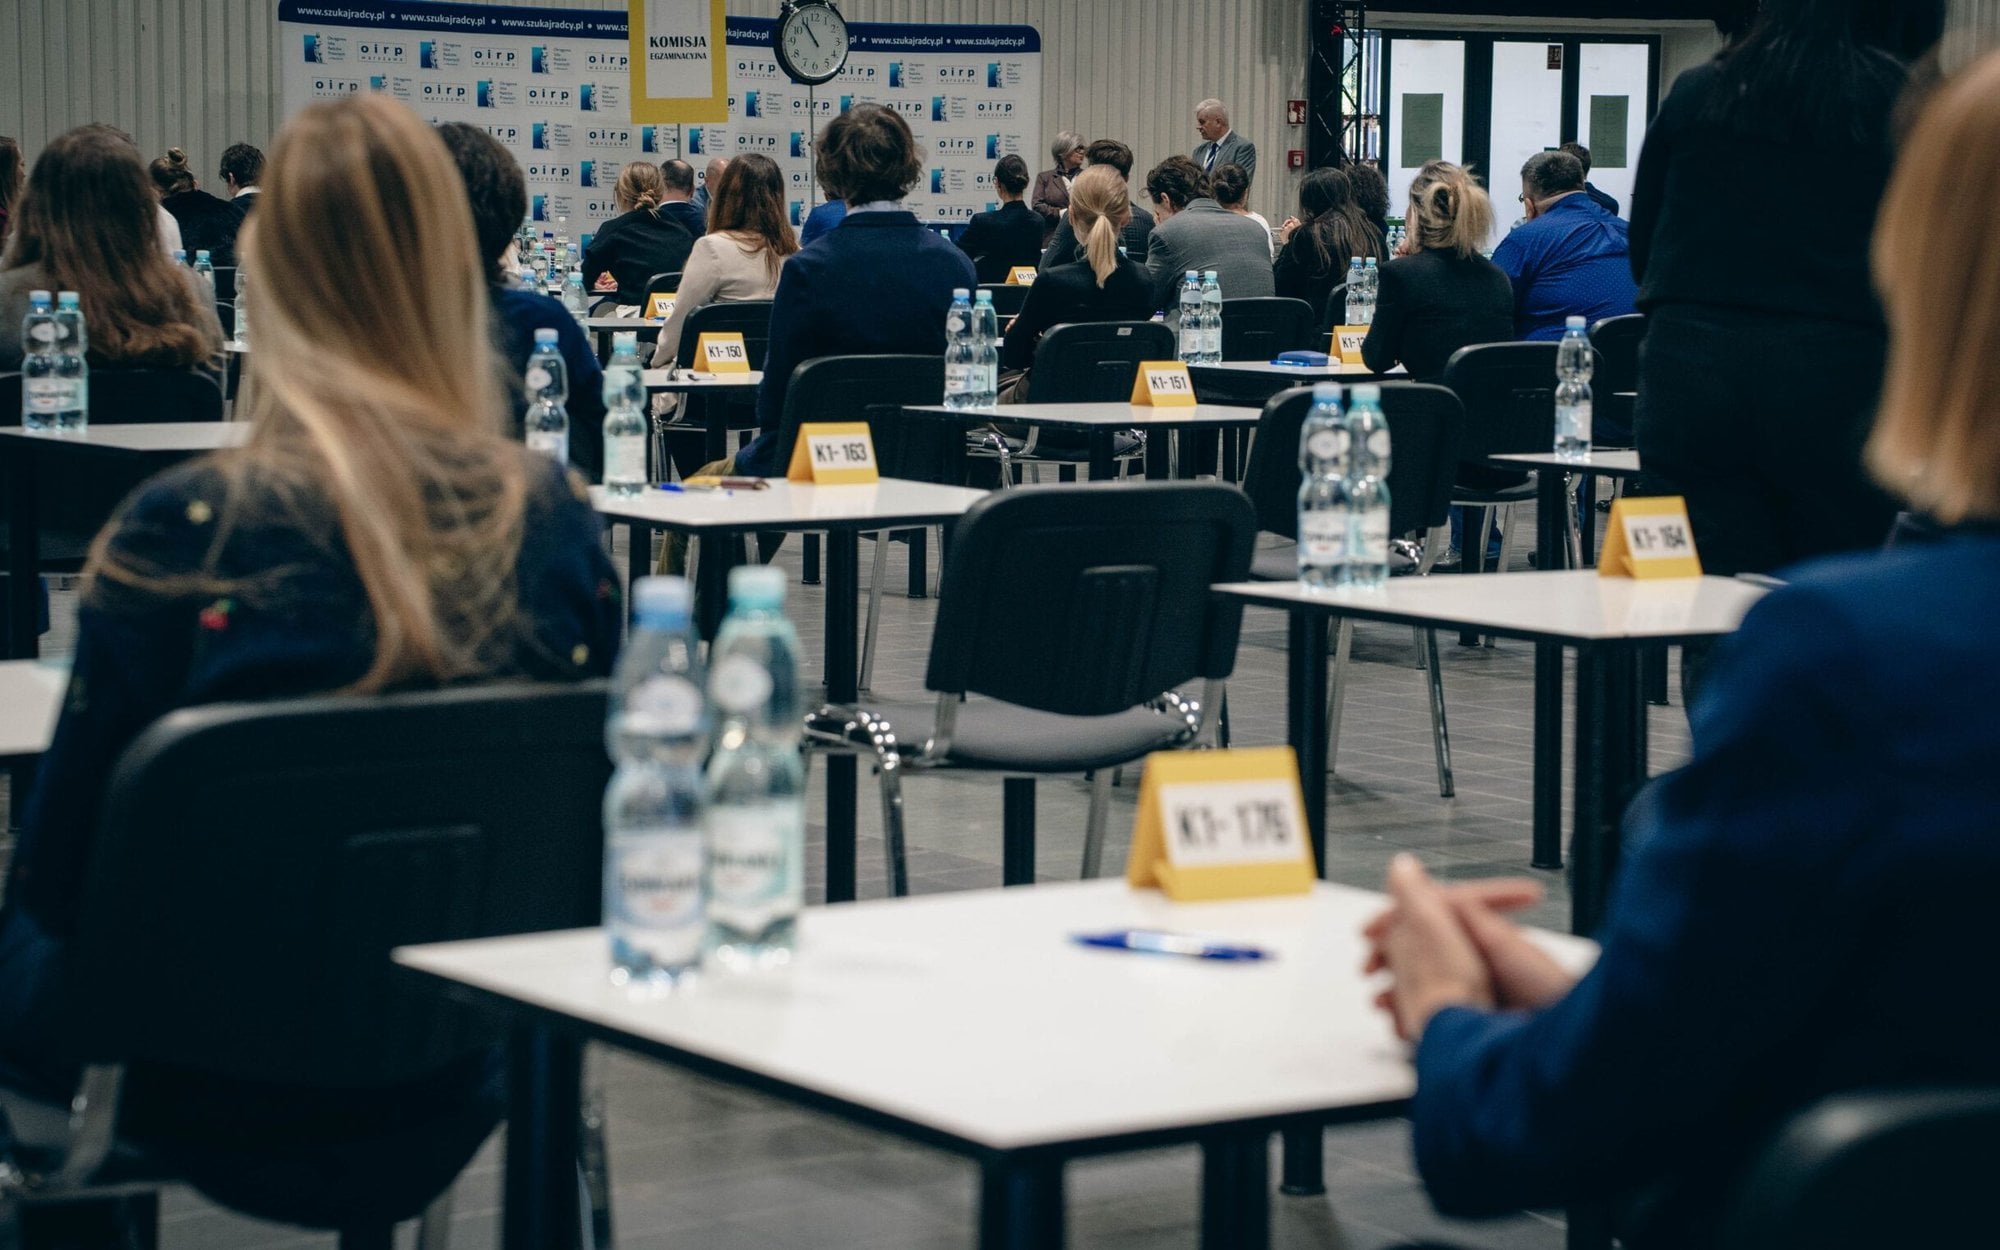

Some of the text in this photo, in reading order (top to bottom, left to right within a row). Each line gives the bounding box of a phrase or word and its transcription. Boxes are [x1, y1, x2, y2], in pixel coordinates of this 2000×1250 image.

[297, 7, 385, 20] www.szukajradcy.pl
[401, 13, 486, 26] www.szukajradcy.pl
[502, 19, 584, 30] www.szukajradcy.pl
[726, 29, 769, 40] kajradcy.pl
[650, 36, 706, 48] KOMISJA
[871, 36, 1026, 47] www.szukajradcy.pl www.szukajradcy.pl
[361, 44, 402, 56] oirp
[474, 50, 515, 61] oirp
[589, 54, 627, 65] oirp
[650, 52, 706, 60] EGZAMINACYJNA
[738, 62, 776, 72] oirp
[940, 68, 974, 77] oirp
[424, 85, 465, 96] oirp
[530, 88, 568, 100] oirp
[978, 102, 1012, 112] oirp
[489, 126, 516, 138] irp
[590, 130, 628, 141] oirp
[738, 136, 775, 147] oirp
[940, 139, 974, 149] oirp
[530, 165, 569, 177] oirp
[590, 202, 615, 211] oir
[658, 302, 675, 310] K1-1
[708, 346, 742, 358] K1-150
[1150, 376, 1187, 390] K1-151
[815, 443, 867, 462] K1-163
